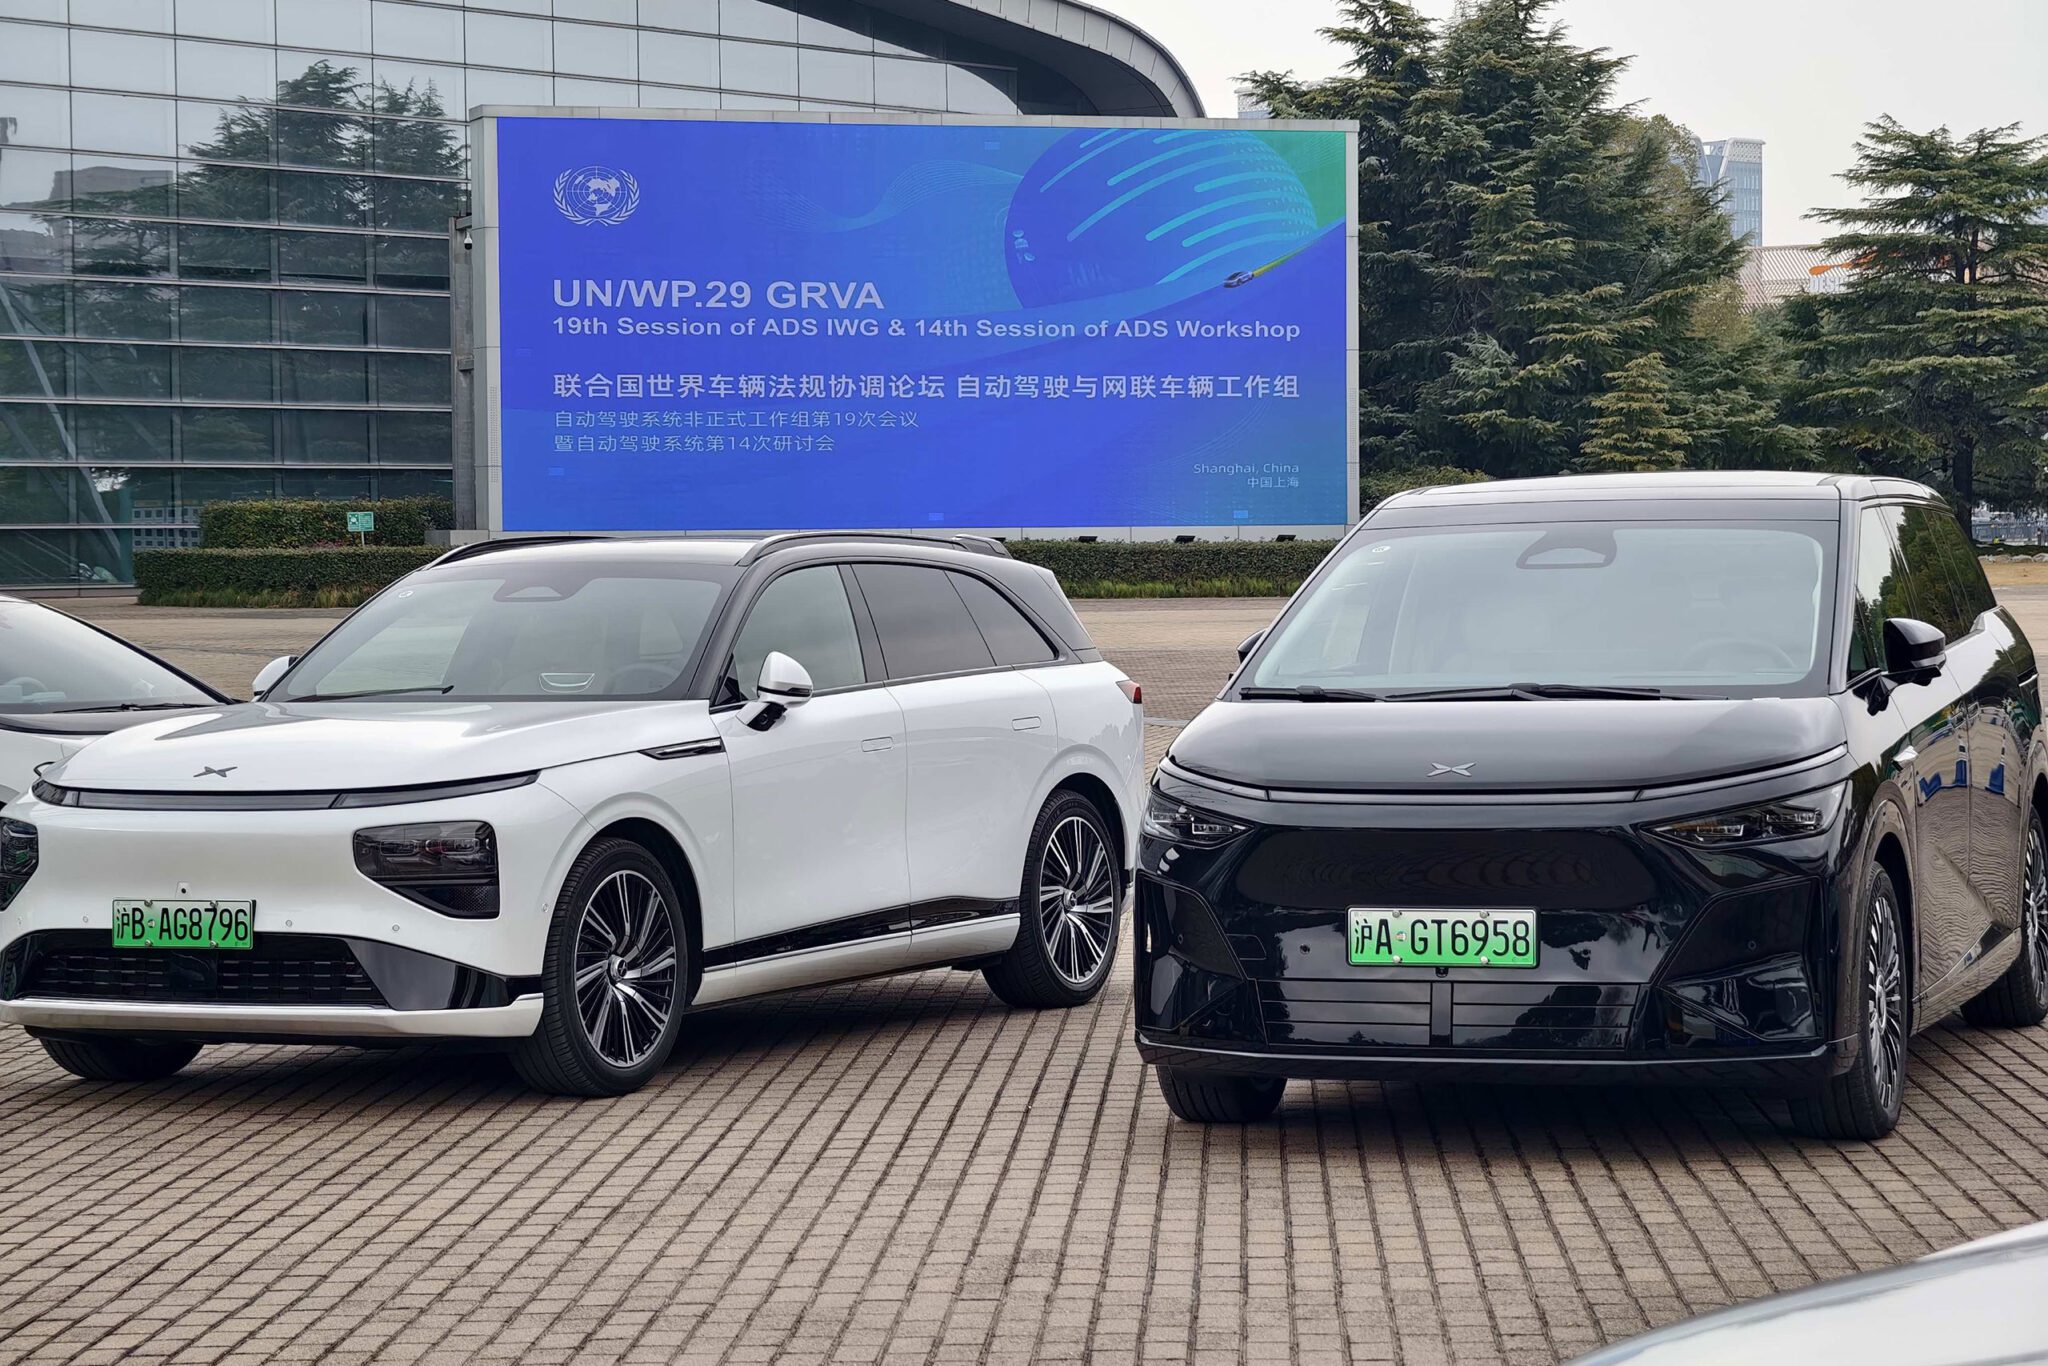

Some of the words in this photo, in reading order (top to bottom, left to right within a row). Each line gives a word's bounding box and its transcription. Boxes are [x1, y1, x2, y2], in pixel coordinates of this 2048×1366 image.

[553, 279, 752, 308] UN/WP.29
[766, 281, 885, 310] GRVA
[553, 316, 608, 335] 19th
[617, 316, 721, 336] Session
[729, 317, 757, 336] of
[762, 318, 818, 336] ADS
[827, 318, 879, 337] IWG
[888, 318, 907, 337] &
[915, 319, 968, 337] 14th
[976, 319, 1076, 338] Session
[1083, 319, 1110, 338] of
[1114, 320, 1169, 338] ADS
[1176, 320, 1301, 342] Workshop
[553, 373, 946, 400] 联合国世界车辆法规协调论坛
[957, 374, 1300, 400] 自动驾驶与网联车辆工作组
[555, 409, 919, 429] 自动驾驶系统非正式工作组第19次会议
[554, 434, 835, 453] 暨自动驾驶系统第14次研讨会
[1193, 463, 1259, 476] Shanghai,
[1263, 463, 1299, 474] China
[1247, 476, 1299, 489] 中国上海
